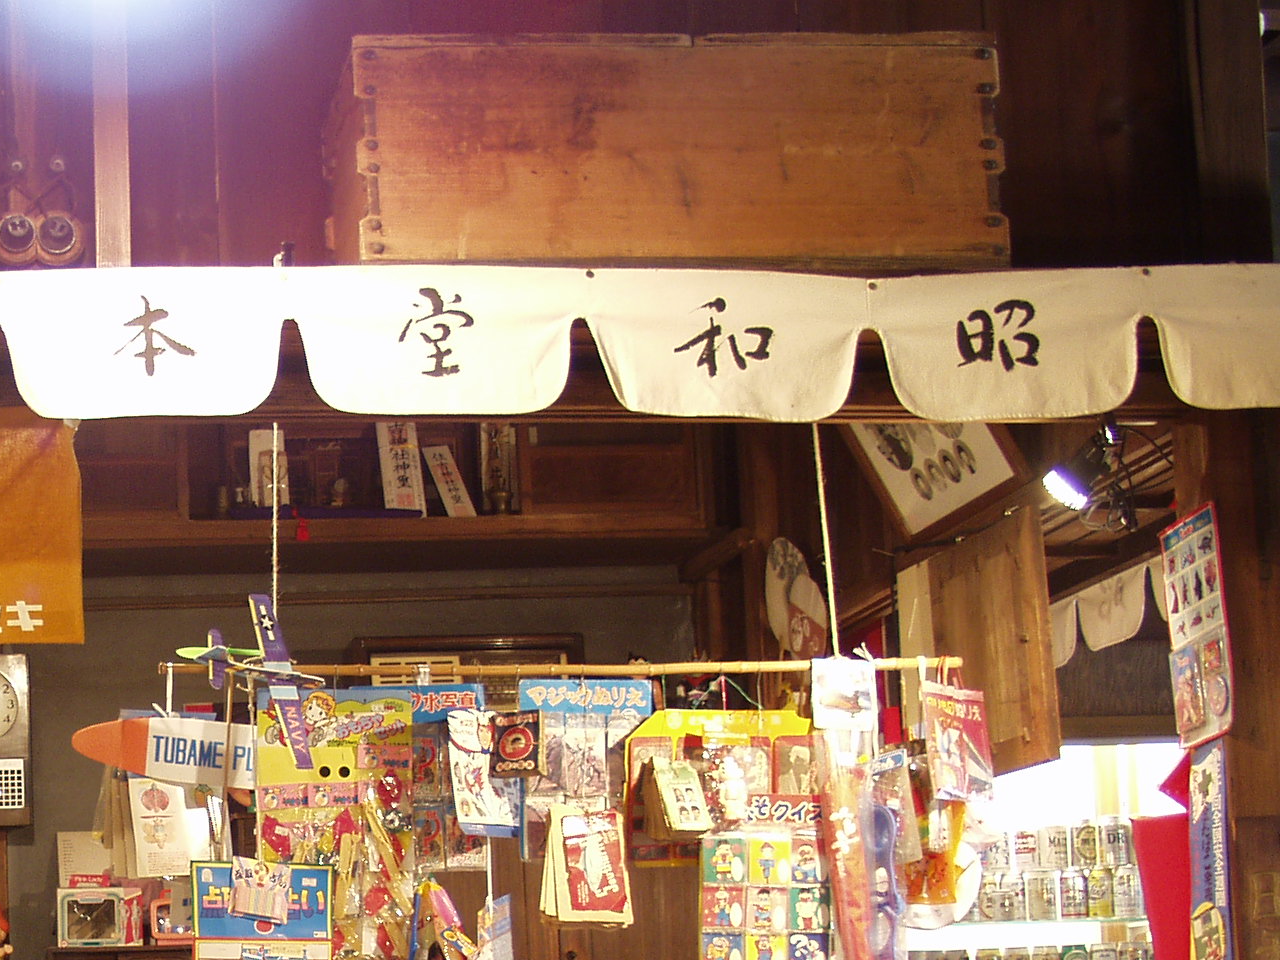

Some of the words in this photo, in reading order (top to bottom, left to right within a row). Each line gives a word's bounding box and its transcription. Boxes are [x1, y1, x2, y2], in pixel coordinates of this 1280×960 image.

[526, 685, 647, 708] マジックぬりえ
[284, 705, 308, 756] NAVY
[335, 713, 385, 739] おもちゃ
[374, 719, 407, 740] セット
[152, 735, 224, 769] TUBAME
